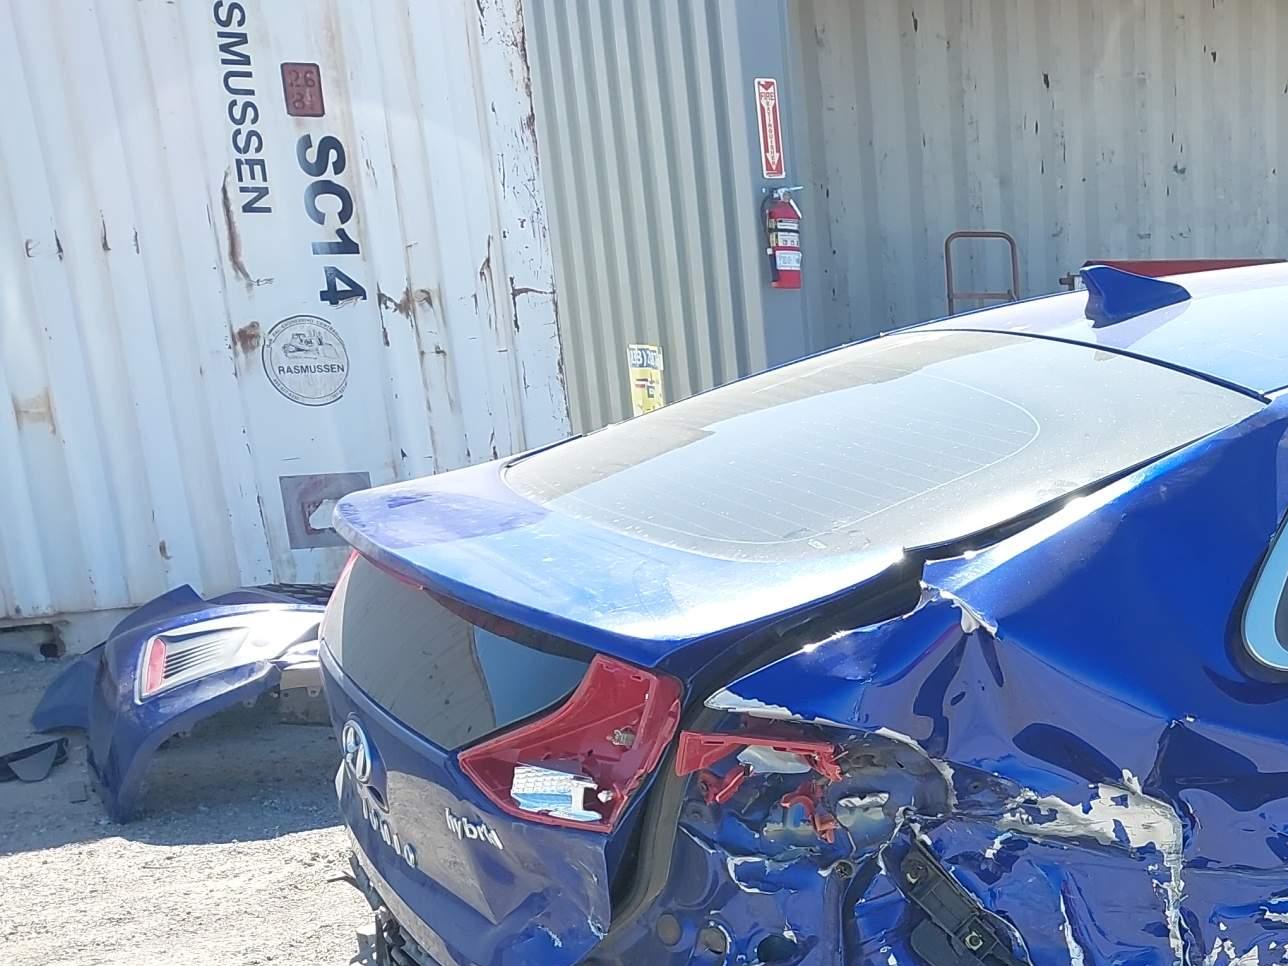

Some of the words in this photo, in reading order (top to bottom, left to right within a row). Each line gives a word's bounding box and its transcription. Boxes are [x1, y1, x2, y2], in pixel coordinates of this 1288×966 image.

[213, 0, 272, 214] SMUSSEN
[296, 134, 367, 306] SC14
[278, 364, 345, 375] RASMUSSEN
